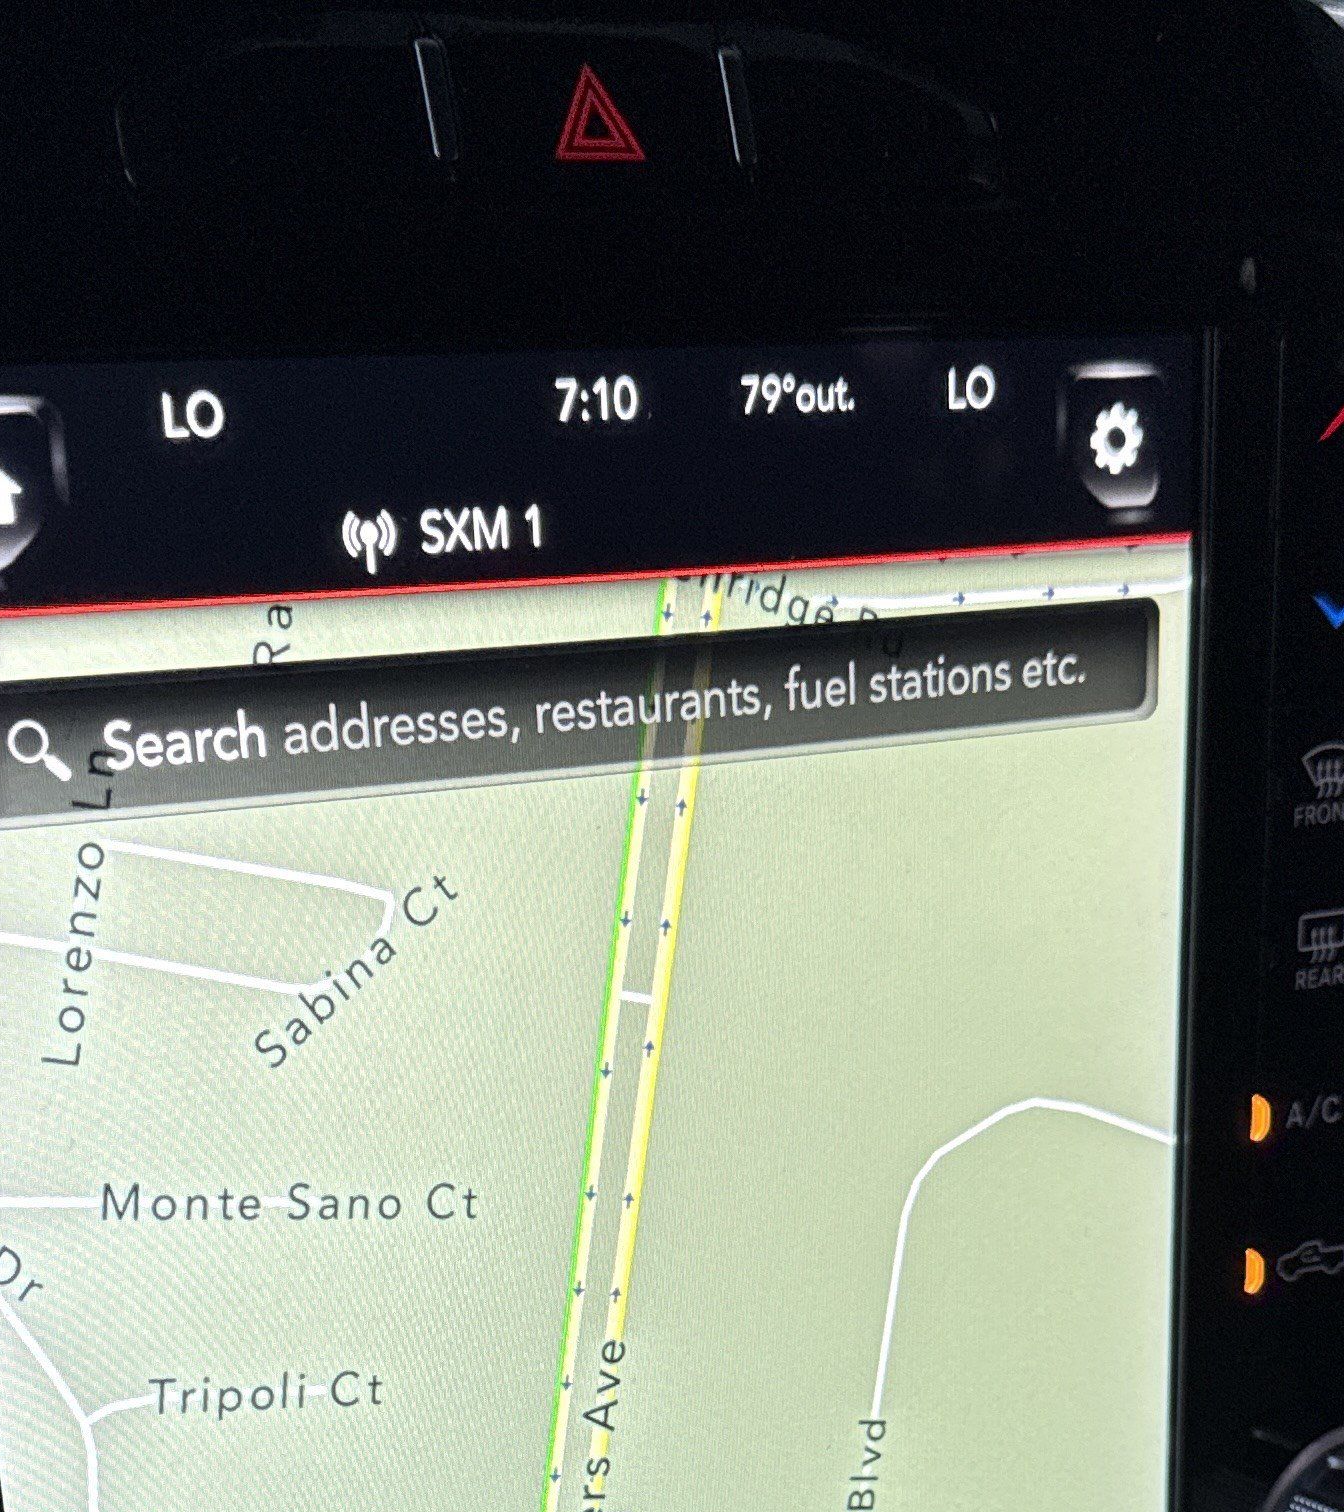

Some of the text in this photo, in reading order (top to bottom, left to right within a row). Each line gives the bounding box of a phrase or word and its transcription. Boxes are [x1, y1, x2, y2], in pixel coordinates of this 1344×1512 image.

[555, 376, 639, 422] 7:10
[947, 364, 995, 411] LO
[162, 390, 224, 438] LO
[419, 504, 542, 554] SXM 1
[102, 649, 1087, 772] Search addresses, restaurants, fuel stations etc.
[42, 749, 116, 1066] Lorenzo Ln
[254, 873, 459, 1069] Sabina Ct
[1285, 1093, 1344, 1130] A/C
[101, 1183, 478, 1221] Monte Sano Ct
[148, 1371, 384, 1421] Tripoli Ct
[582, 1338, 626, 1431] Ave
[846, 1417, 888, 1511] Blvd
